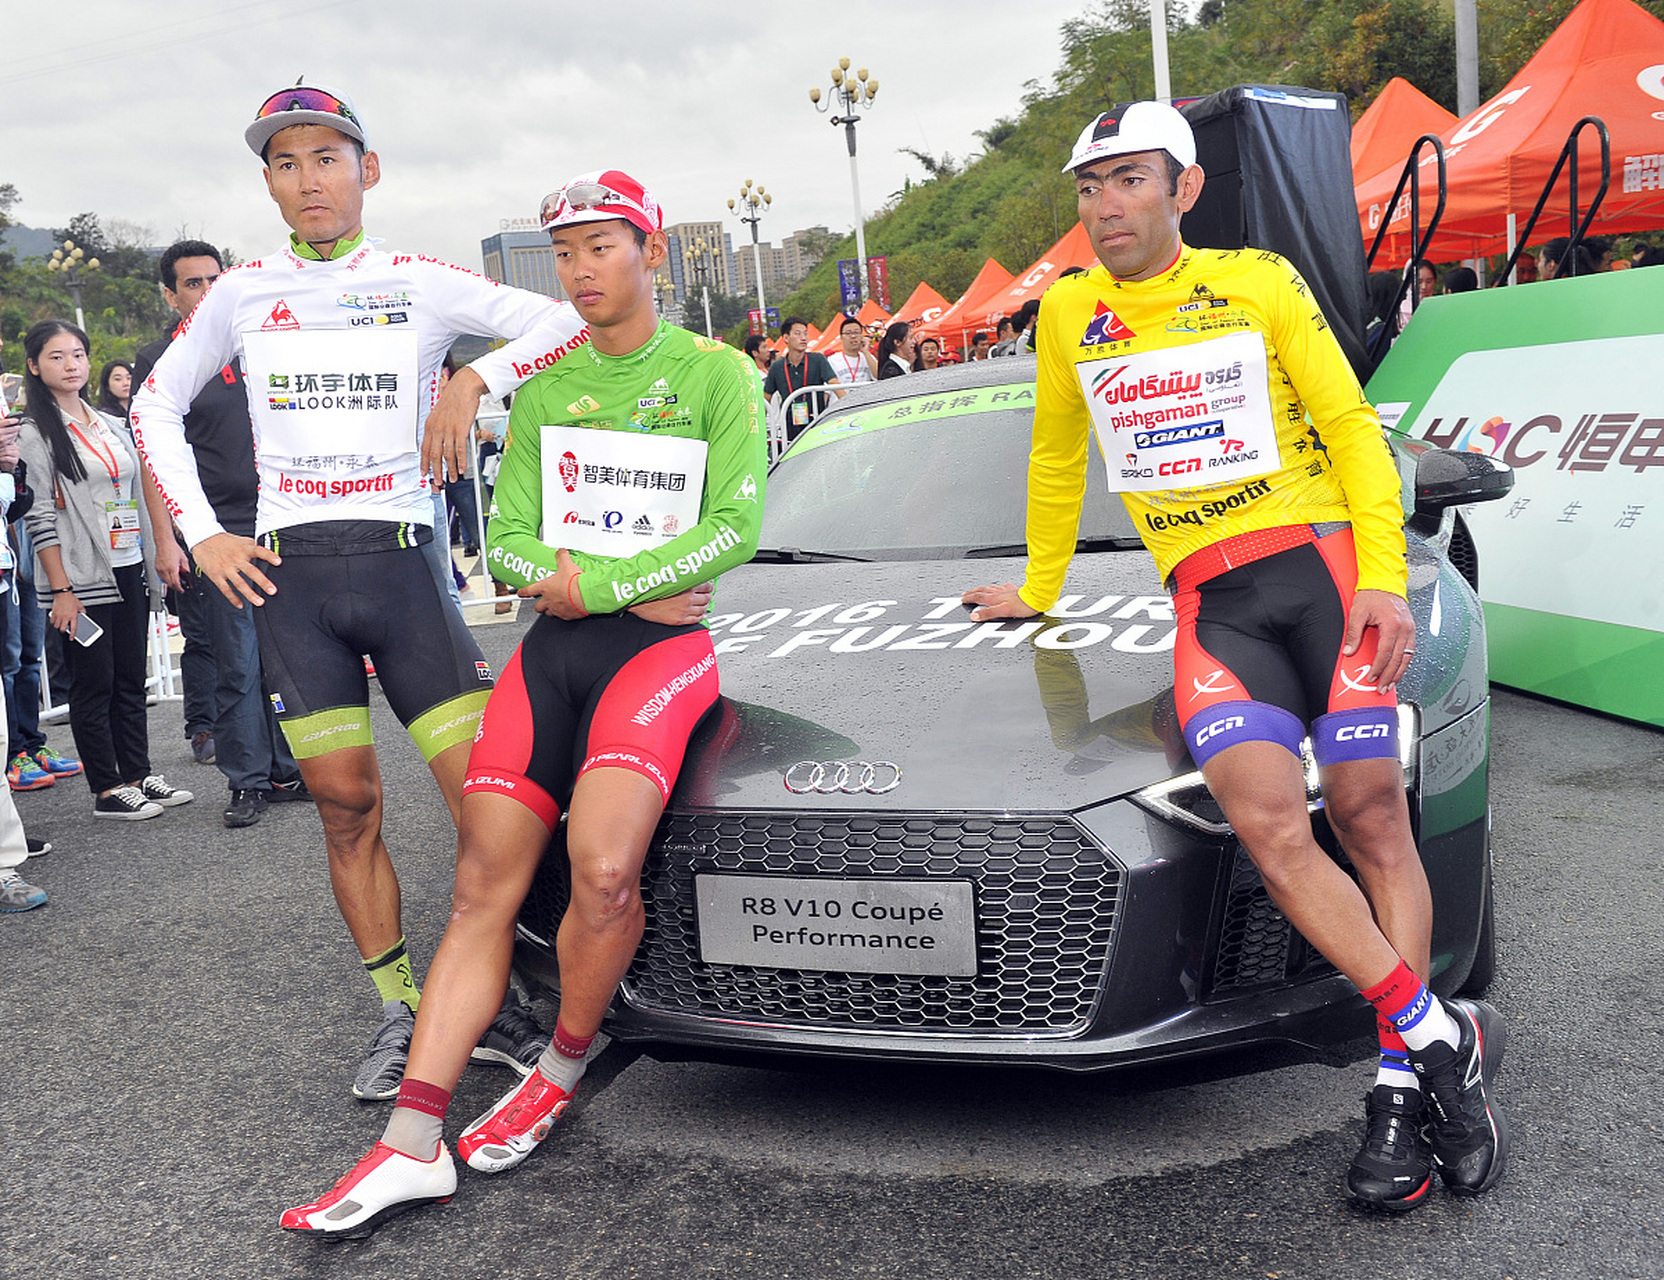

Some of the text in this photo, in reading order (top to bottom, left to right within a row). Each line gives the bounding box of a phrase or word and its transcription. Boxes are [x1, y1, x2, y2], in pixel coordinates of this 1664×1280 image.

[1623, 153, 1664, 193] 解
[1179, 303, 1199, 313] UCI
[351, 317, 374, 327] UCI
[295, 373, 399, 393] 环宇体育
[991, 390, 1034, 403] RA
[888, 394, 978, 420] 总指挥
[1110, 402, 1208, 433] pishgaman
[1152, 424, 1220, 443] GIANT
[1209, 450, 1258, 468] RANKING
[279, 472, 395, 499] le coq sportif
[583, 464, 687, 491] 智美体育集团
[1145, 513, 1167, 532] le
[1202, 478, 1272, 517] sportif
[503, 550, 534, 583] coq
[611, 580, 635, 602] le
[635, 561, 679, 595] coq
[709, 595, 1177, 635] 2016 TUR
[766, 622, 1178, 658] FUZHOU
[596, 752, 643, 766] PEARL
[475, 776, 516, 790] IZUMI
[742, 896, 944, 927] R8 V10 Coupé
[752, 924, 936, 950] Performance
[1397, 988, 1429, 1026] GIANT
